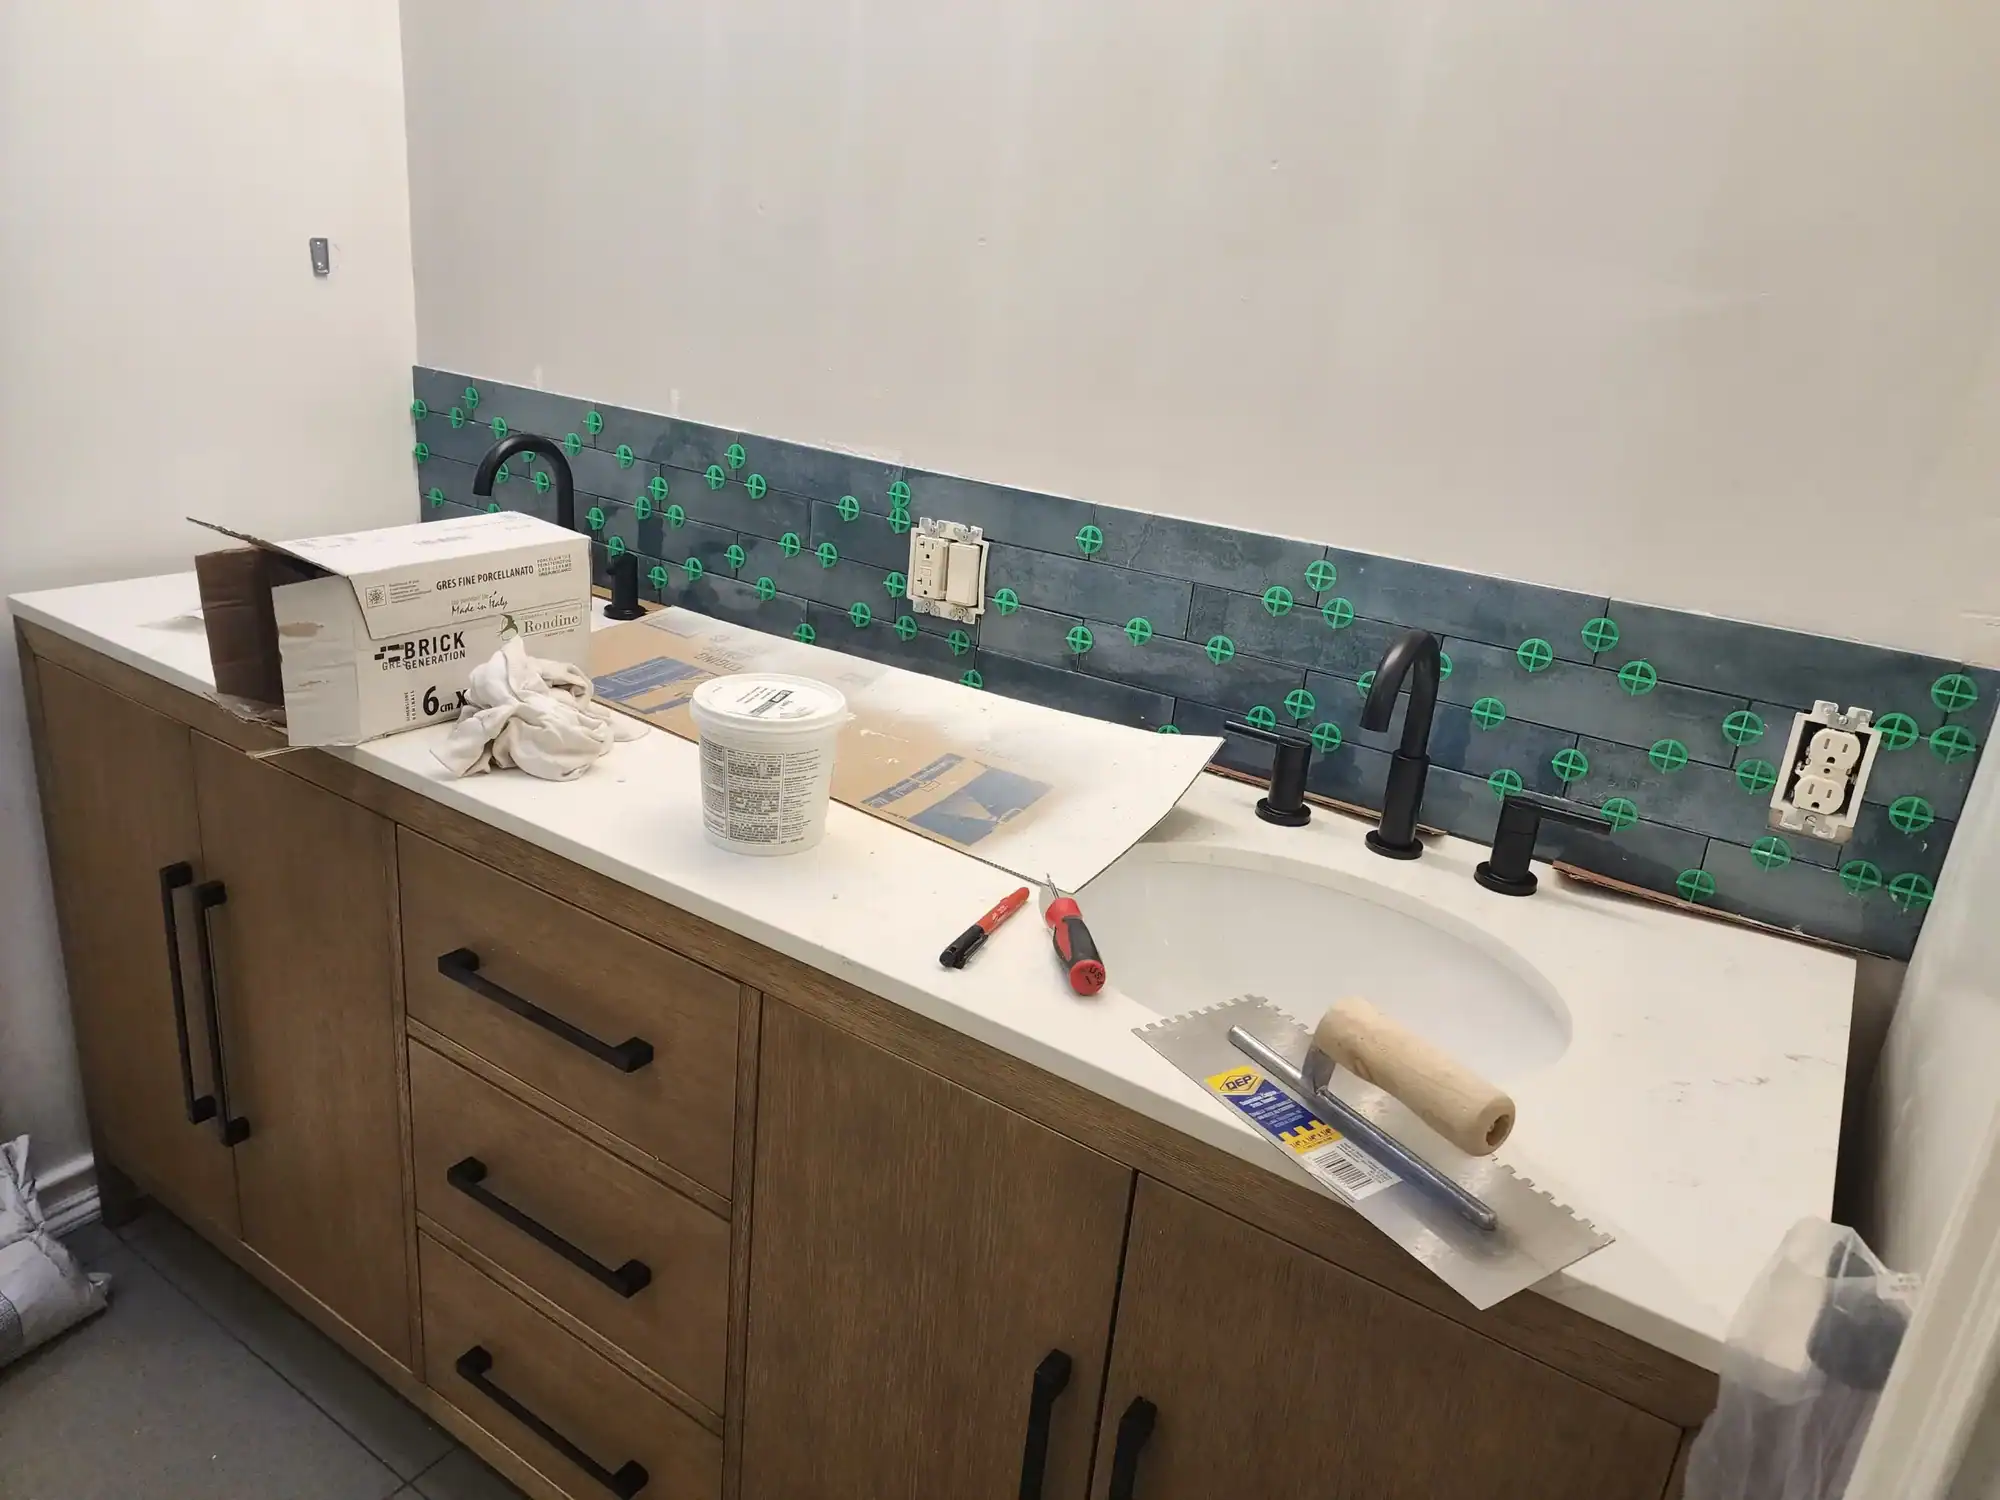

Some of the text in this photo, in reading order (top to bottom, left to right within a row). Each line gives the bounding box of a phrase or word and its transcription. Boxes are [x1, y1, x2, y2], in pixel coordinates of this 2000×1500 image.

[437, 579, 456, 591] GRES
[458, 575, 475, 587] FINE
[477, 565, 534, 583] PORCELLANATO
[451, 601, 474, 616] Made
[476, 602, 487, 610] in
[488, 591, 508, 610] Italy
[524, 614, 578, 634] Rondine
[404, 631, 465, 660] BRICK
[405, 649, 466, 670] GENERATION
[423, 685, 439, 716] 6
[440, 702, 453, 713] cm
[1226, 1075, 1252, 1090] QEP
